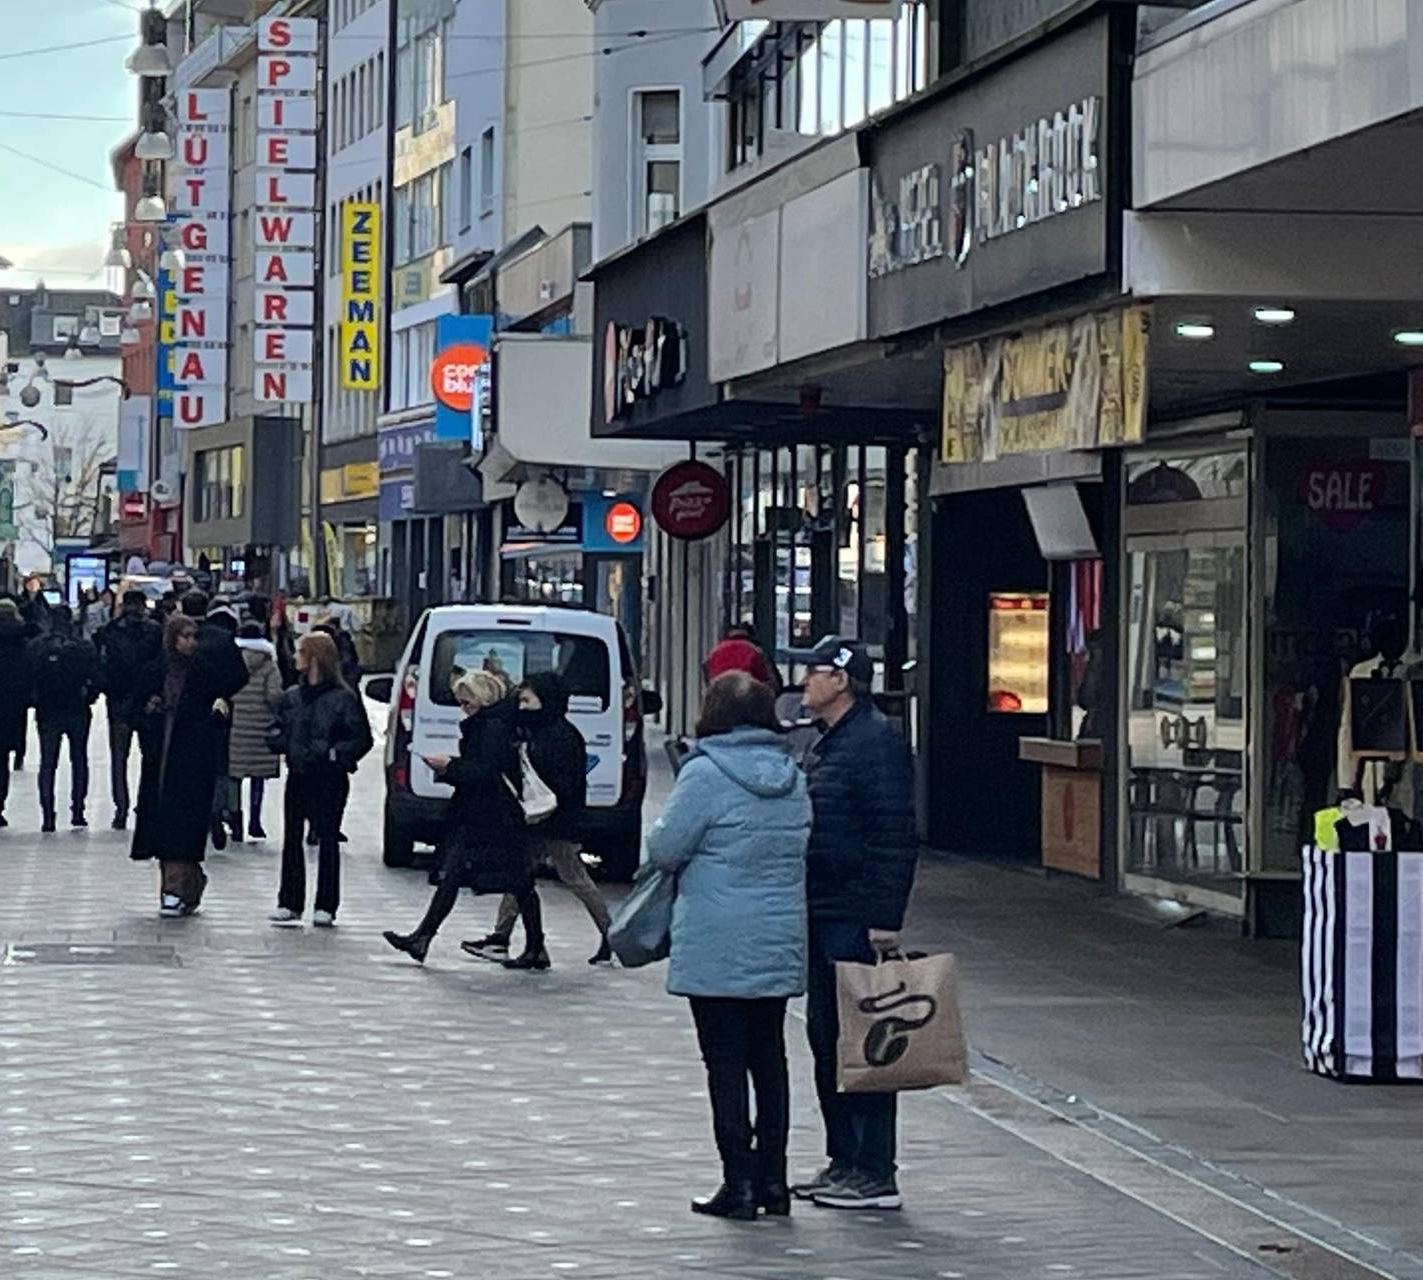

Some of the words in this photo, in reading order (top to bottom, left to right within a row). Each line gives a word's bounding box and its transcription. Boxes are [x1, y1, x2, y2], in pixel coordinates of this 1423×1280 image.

[180, 93, 208, 424] LÜTGENAU
[260, 20, 293, 399] SPIELWAREN
[346, 210, 375, 383] ZEEMAN
[1308, 471, 1373, 511] SALE
